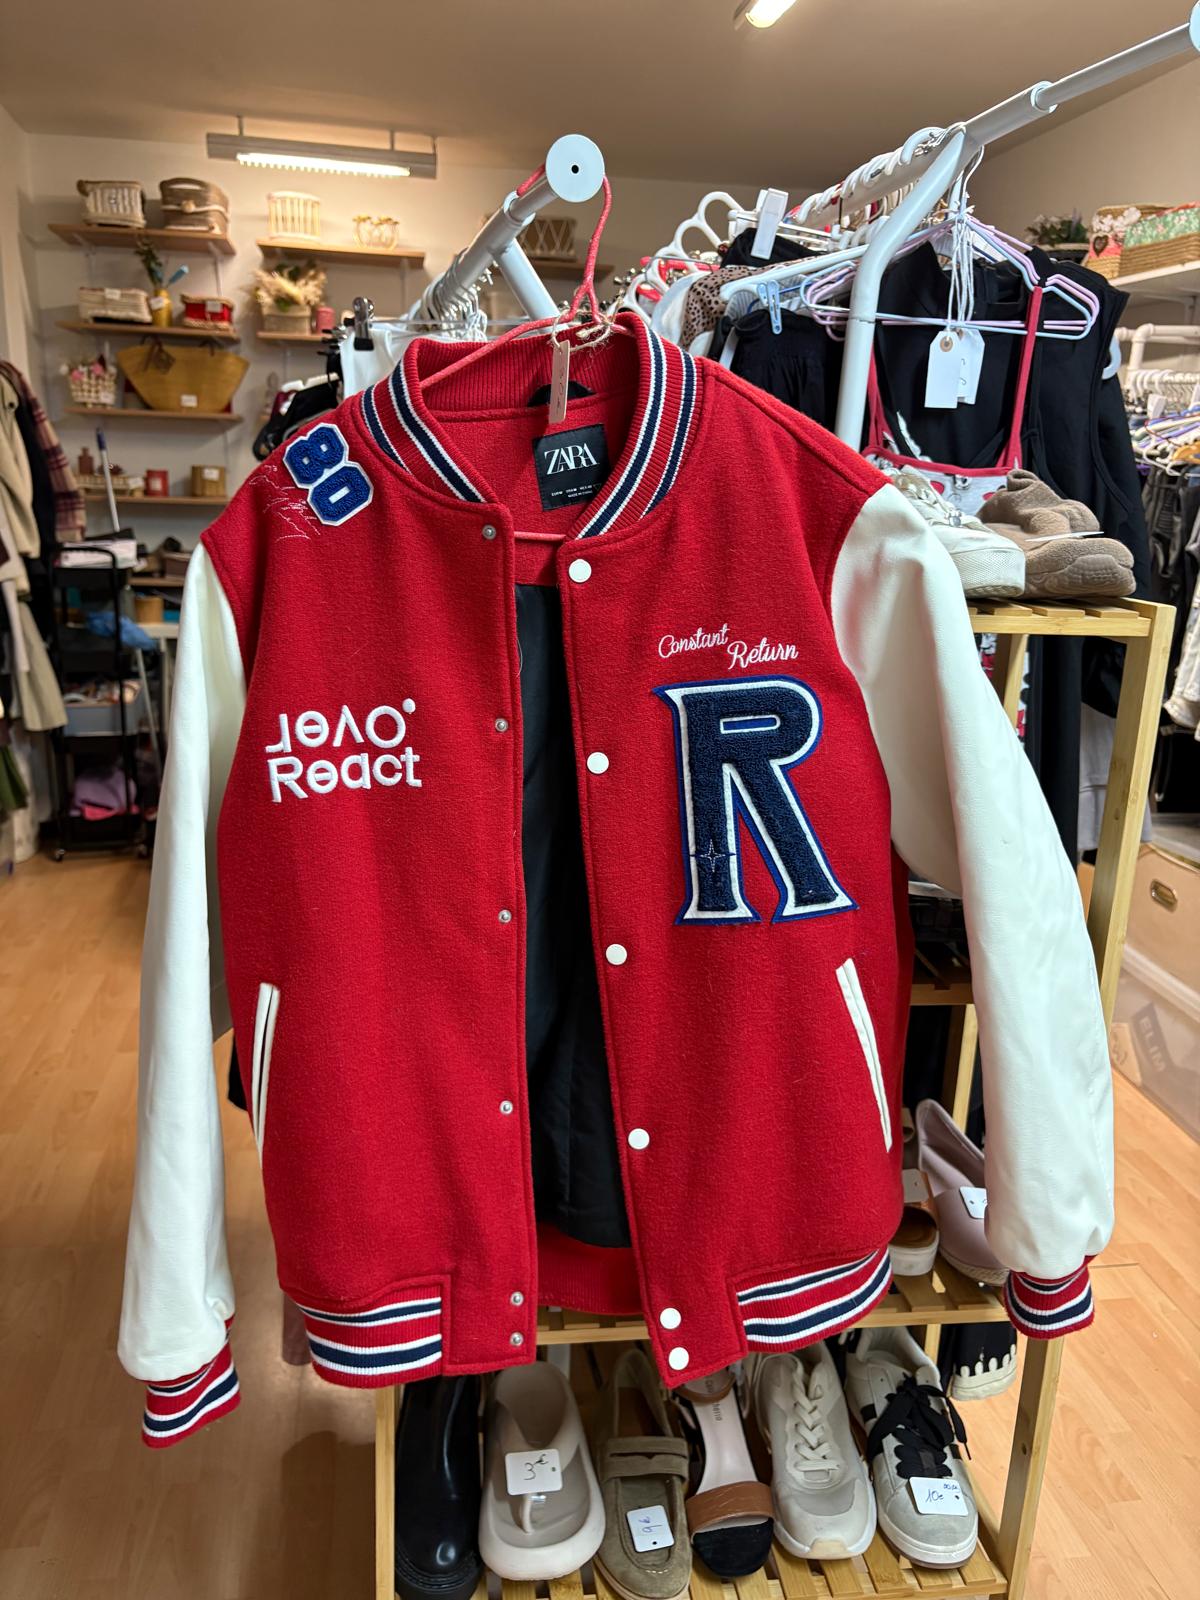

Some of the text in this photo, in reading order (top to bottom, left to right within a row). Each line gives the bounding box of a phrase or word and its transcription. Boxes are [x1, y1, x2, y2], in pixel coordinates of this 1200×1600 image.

[544, 443, 600, 475] ZARA
[658, 623, 799, 670] Constant Return
[267, 746, 423, 803] React
[652, 674, 860, 925] R
